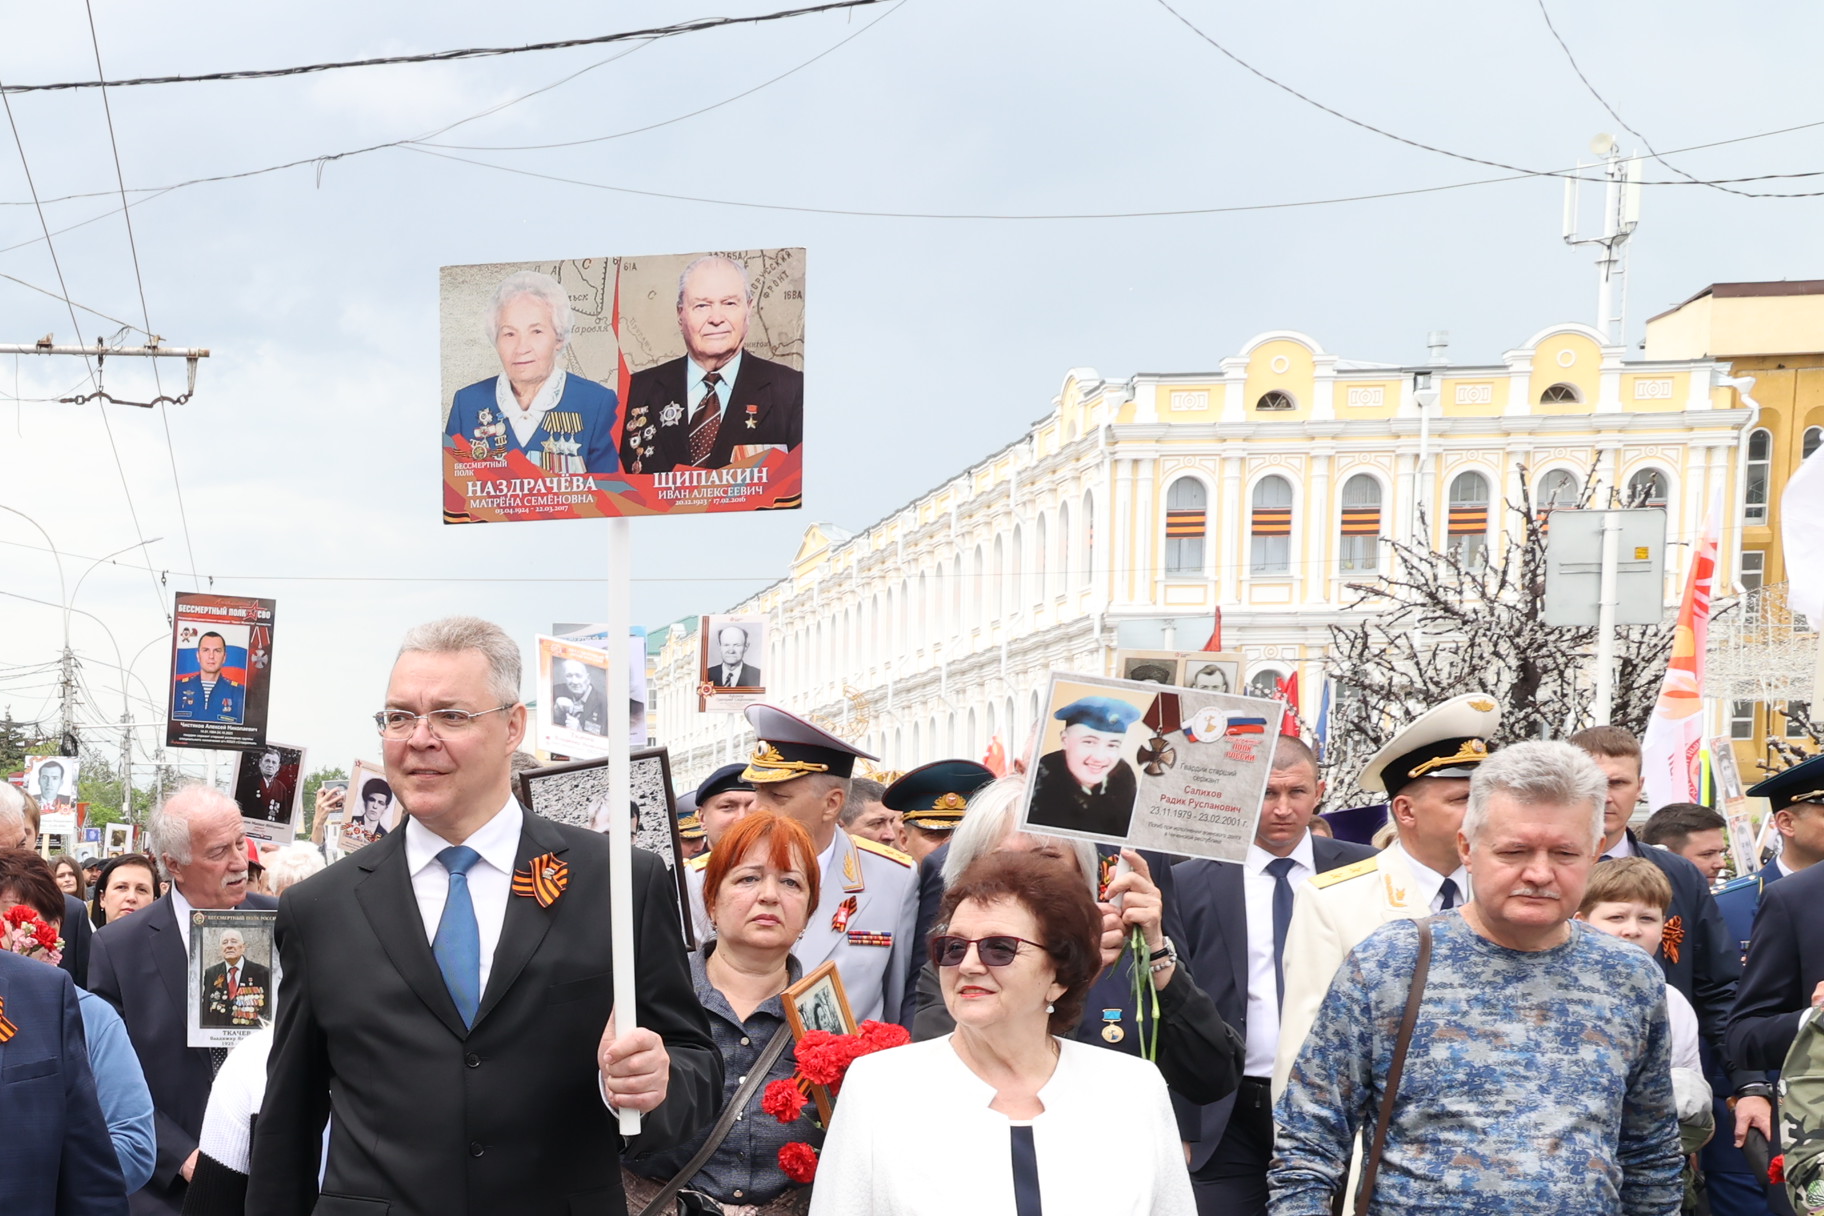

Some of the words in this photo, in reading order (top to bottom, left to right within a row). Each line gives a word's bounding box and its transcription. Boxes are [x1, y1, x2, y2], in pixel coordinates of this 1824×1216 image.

[763, 270, 789, 299] ФРОНТ
[454, 461, 507, 470] БЕССМЕРТНЫЙ
[467, 473, 597, 498] НАЗДРАЧЁВА
[653, 467, 769, 490] ЩИПАКИН
[658, 489, 689, 500] ИВАН
[692, 486, 763, 498] АЛЕКСЕЕВИЧ
[470, 497, 522, 509] МАТРЁНА
[524, 494, 594, 506] СЕМЁНОВНА
[713, 497, 746, 505] 17.02.2016
[495, 506, 528, 515] 03.04.1924
[535, 505, 569, 513] 22.03.2017
[178, 604, 227, 615] БЕССМЕРТНЫЙ
[228, 608, 247, 617] ПОЛК
[257, 610, 271, 619] СВО
[1180, 762, 1208, 774] Гвардии
[1209, 767, 1237, 777] старший
[1193, 774, 1219, 784] сержант
[1184, 785, 1222, 798] Салихов
[1160, 794, 1186, 806] Радик
[1188, 798, 1241, 813] Русланович
[1150, 806, 1192, 820] 23.11.1979
[1199, 813, 1241, 827] 23.02.2001
